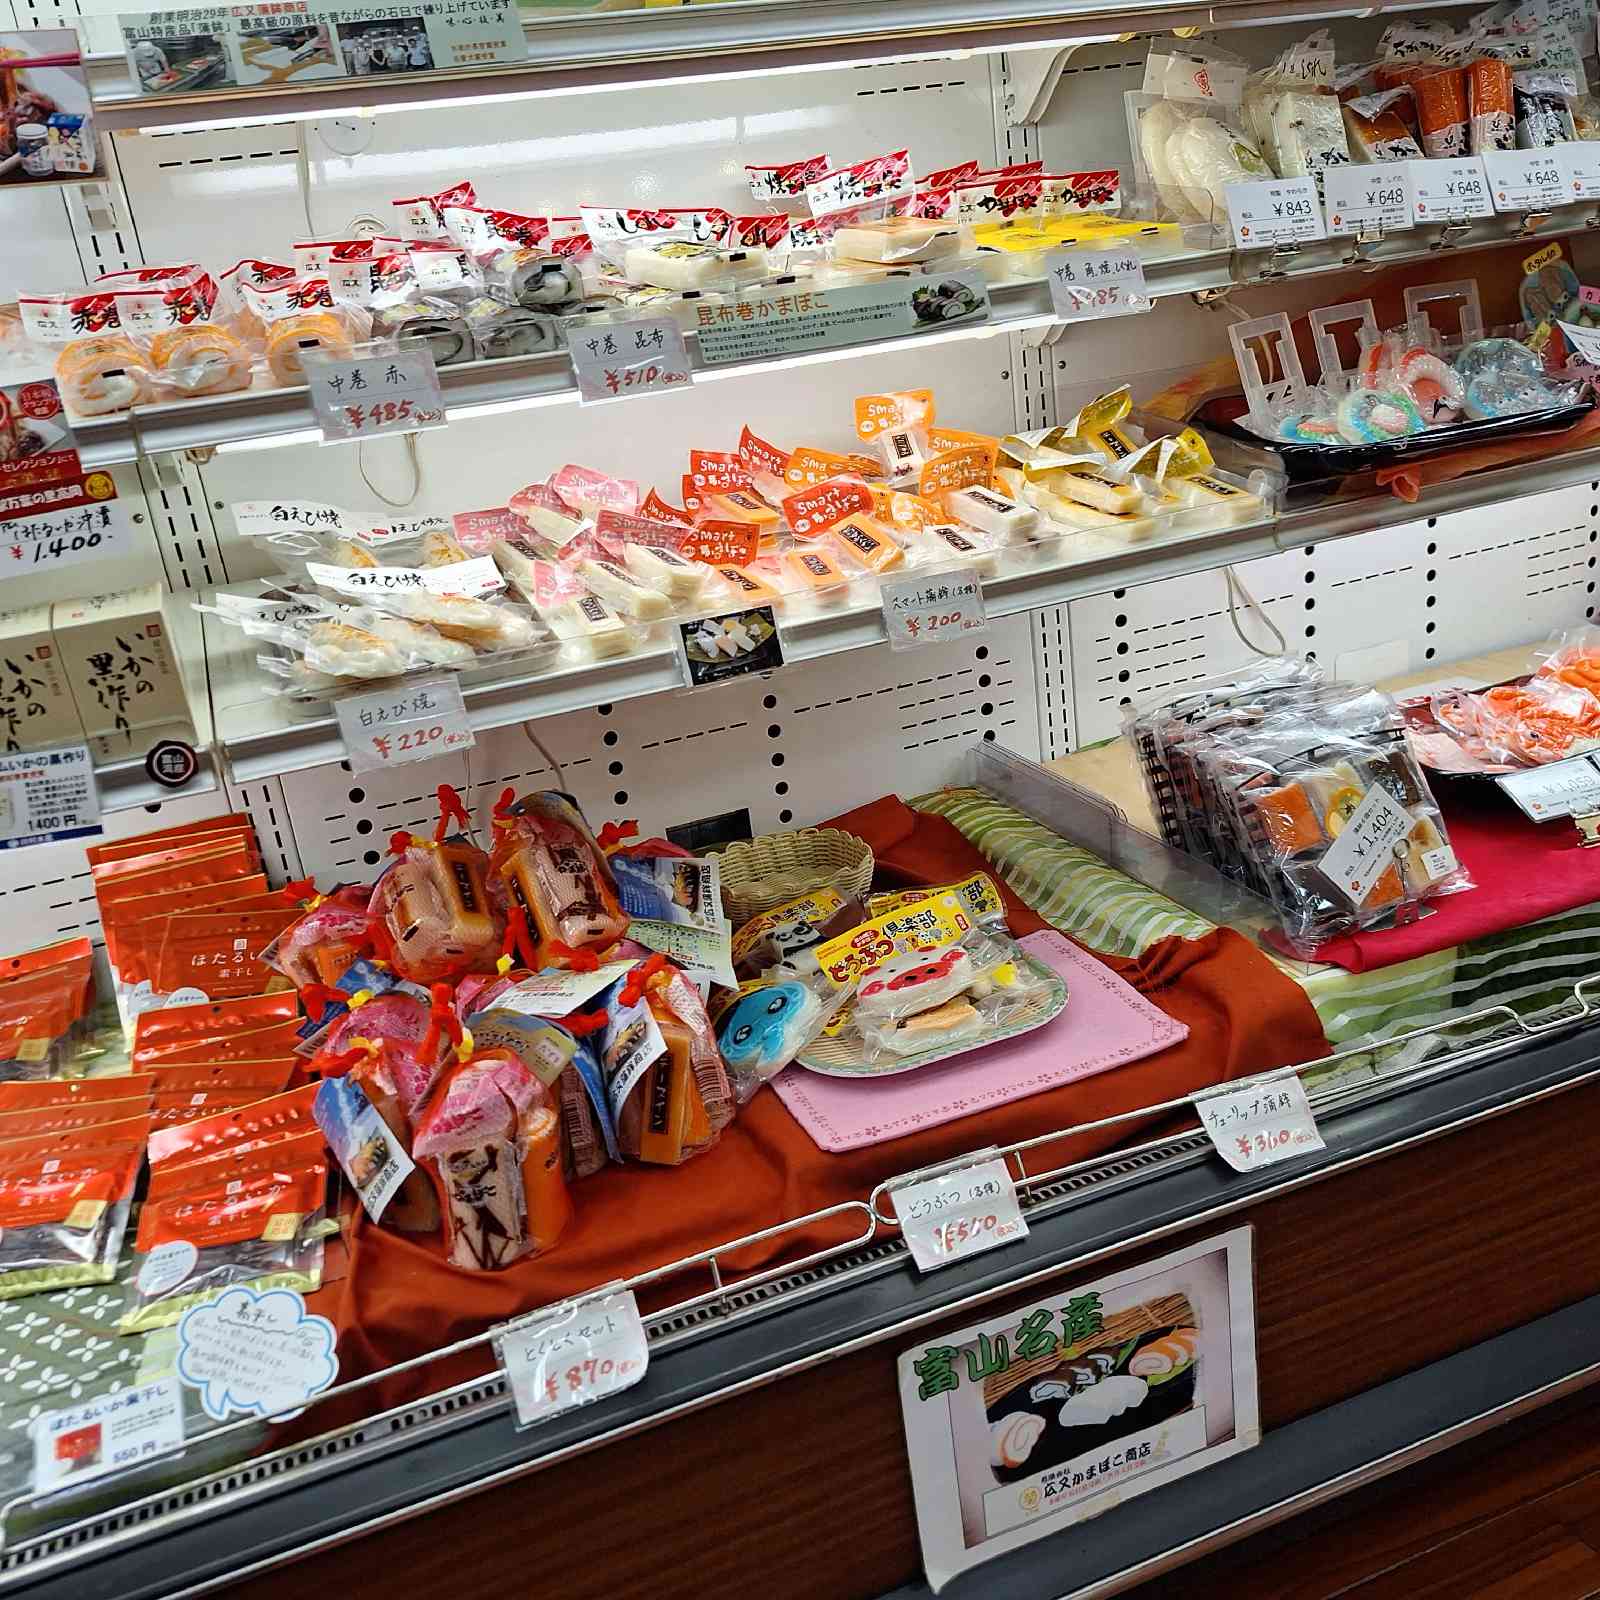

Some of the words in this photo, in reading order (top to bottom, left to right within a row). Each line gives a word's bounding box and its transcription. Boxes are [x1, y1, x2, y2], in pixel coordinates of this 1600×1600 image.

[150, 7, 229, 25] 創業明治29年
[1446, 179, 1483, 196] ¥648
[1523, 169, 1560, 186] ¥648
[1272, 199, 1312, 217] ¥843
[1366, 188, 1404, 206] ¥648
[696, 292, 830, 327] 昆布巻かまぼこ
[586, 333, 618, 357] 中巻
[634, 328, 664, 350] 昆布
[328, 368, 368, 394] 中巻
[385, 364, 407, 385] 赤
[604, 365, 658, 394] ¥510
[345, 399, 415, 430] ¥485
[700, 459, 740, 473] Smart
[932, 455, 974, 476] Smart
[797, 486, 842, 516] Smart
[690, 530, 736, 543] Smart
[905, 611, 962, 638] ¥200
[359, 691, 437, 727] 白えび焼
[371, 725, 445, 760] ¥220
[28, 813, 78, 832] 1400円
[1352, 805, 1393, 857] ¥1,404
[882, 908, 938, 940] 倶楽部
[828, 939, 895, 983] どうぶつ
[908, 1190, 962, 1219] どうぶつ
[913, 1291, 1104, 1402] 富山名産
[545, 1358, 614, 1402] ¥870
[1043, 1442, 1152, 1499] 広又かまぼこ商店
